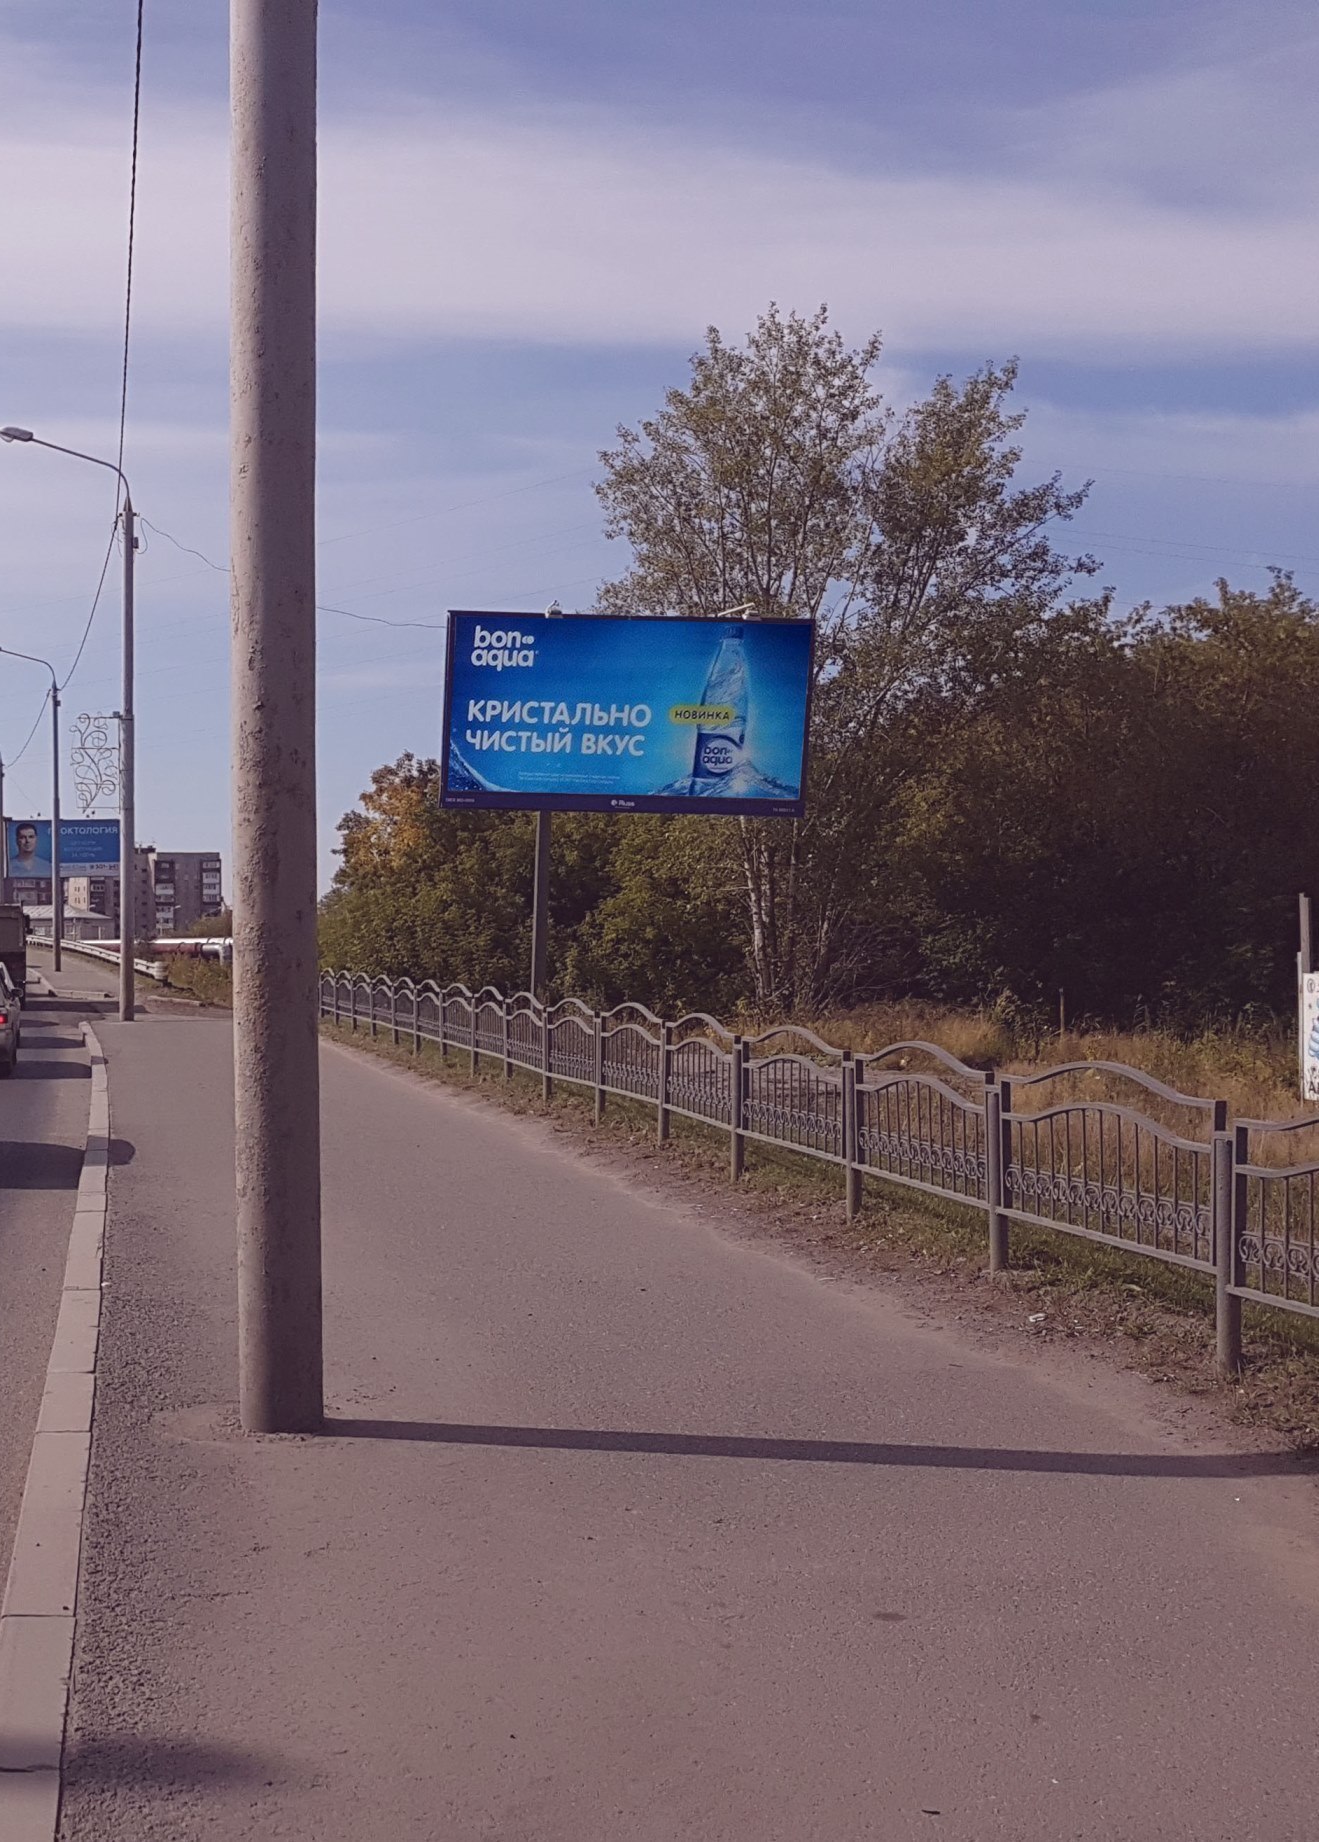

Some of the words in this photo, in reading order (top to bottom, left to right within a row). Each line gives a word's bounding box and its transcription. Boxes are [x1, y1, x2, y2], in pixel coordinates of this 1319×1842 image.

[471, 649, 535, 671] aqua
[467, 700, 652, 727] КРИСТАЛЬНО
[674, 710, 730, 720] НОВИНКА
[465, 727, 572, 753] ЧИСТЫЙ
[580, 733, 645, 756] ВКУС
[47, 825, 119, 835] ПОКТОЛОГИЯ
